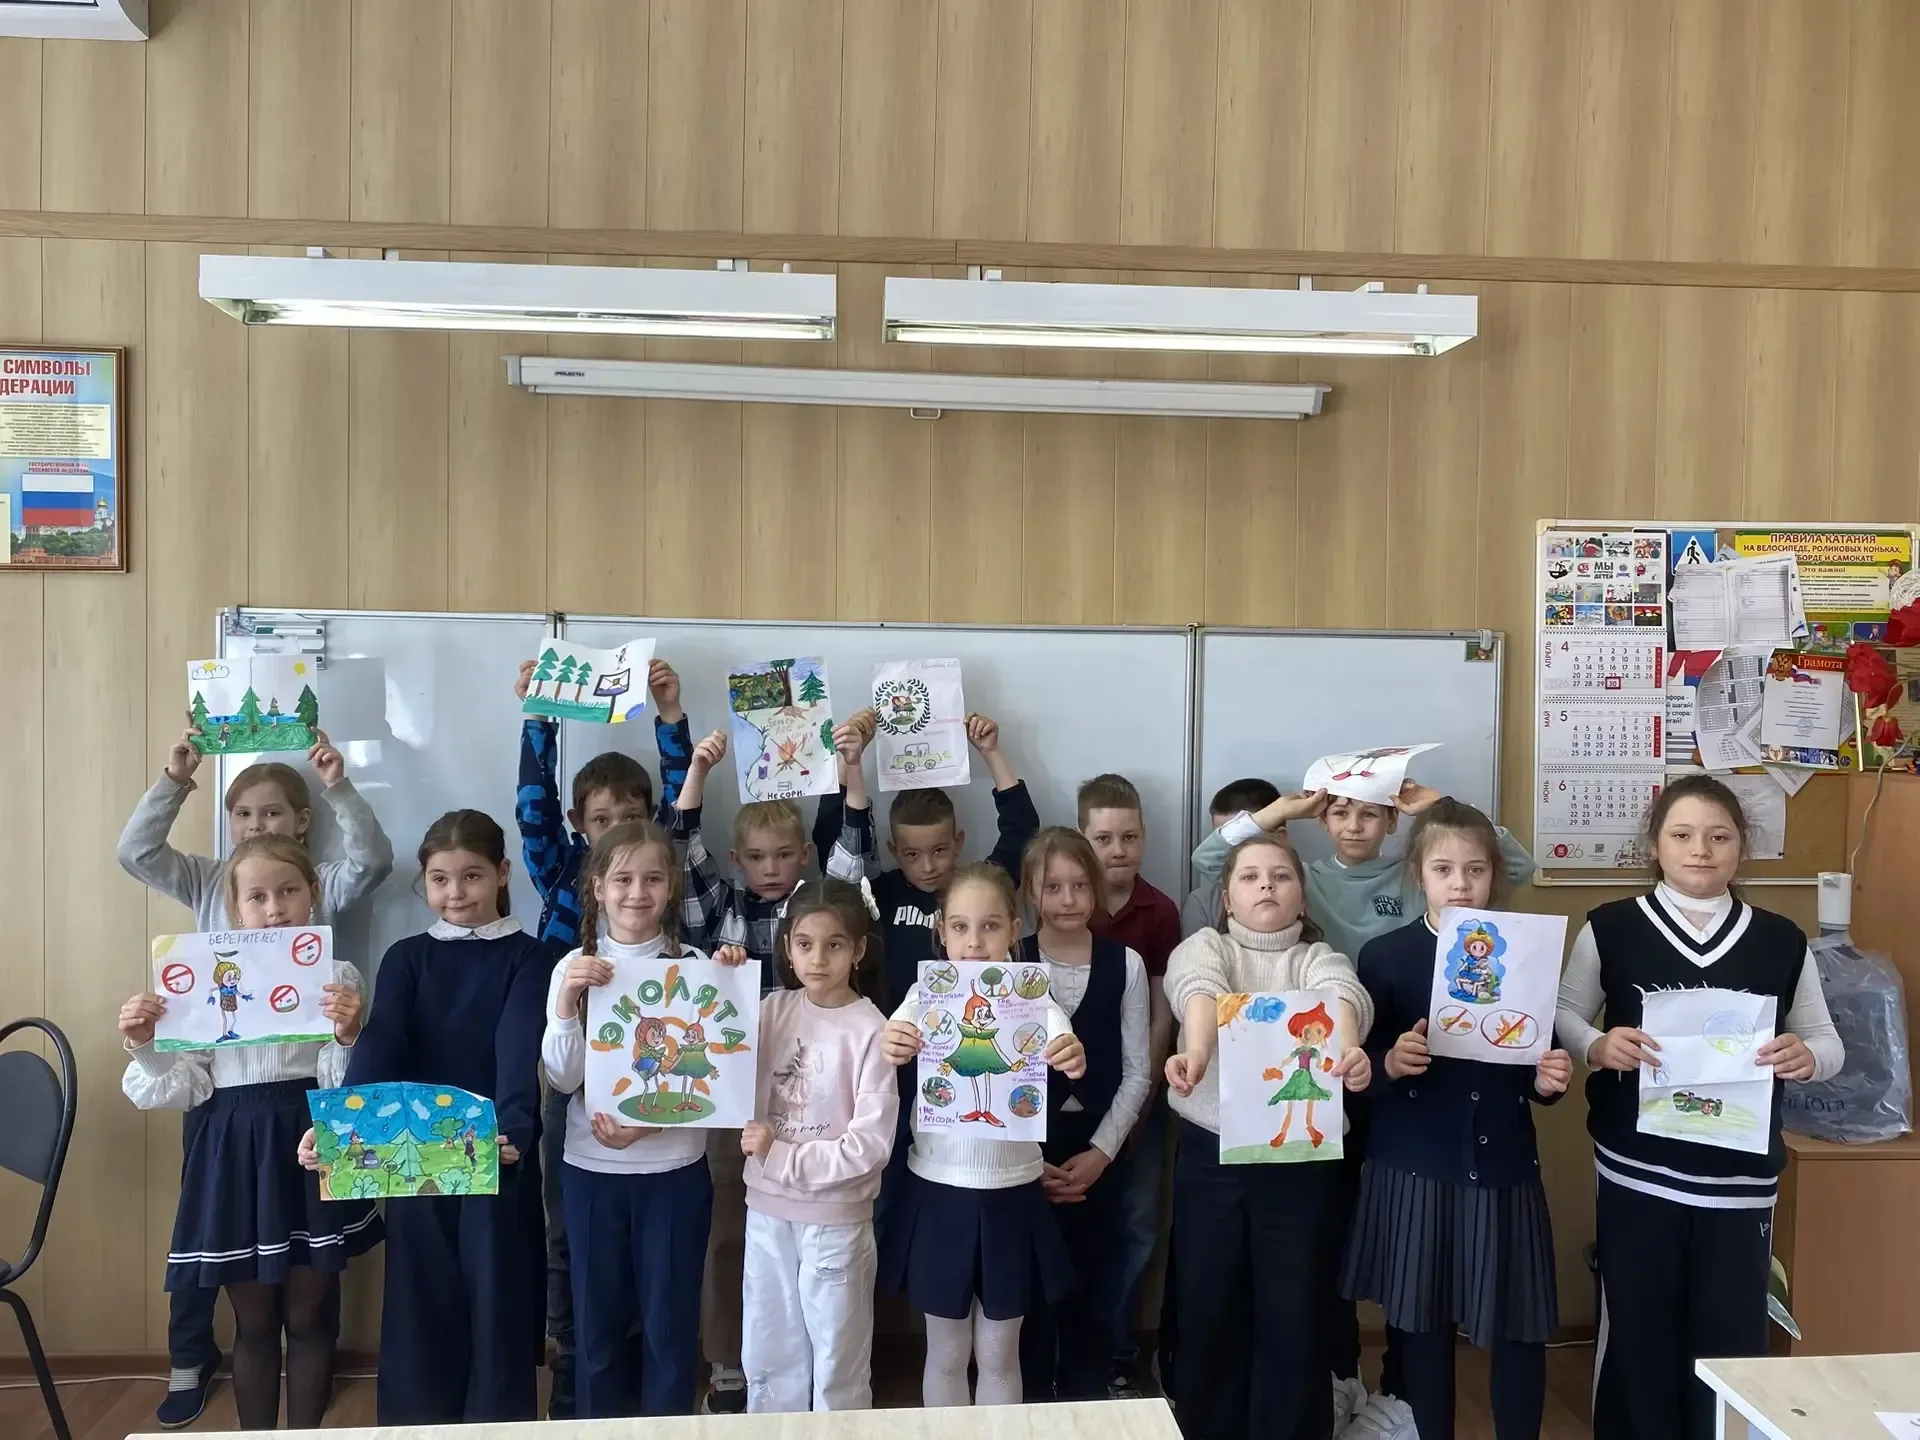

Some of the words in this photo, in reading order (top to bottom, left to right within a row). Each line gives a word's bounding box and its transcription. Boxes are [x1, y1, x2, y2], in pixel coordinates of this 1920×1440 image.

[3, 359, 91, 376] СИМВОЛЫ
[0, 378, 75, 396] ДЕРАЦИИ
[1770, 533, 1822, 544] ПРАВИЛА
[1825, 534, 1876, 545] КАТАНИЯ
[1756, 544, 1810, 553] ВЕЛОСИПЕДЕ,
[1863, 546, 1902, 554] КОНЬКАХ,
[1594, 561, 1614, 570] МЫ
[1561, 641, 1569, 652] 4
[1797, 656, 1842, 669] Грамота
[1560, 711, 1568, 721] 5
[1558, 780, 1566, 791] 6
[1805, 1096, 1844, 1112] Юга
